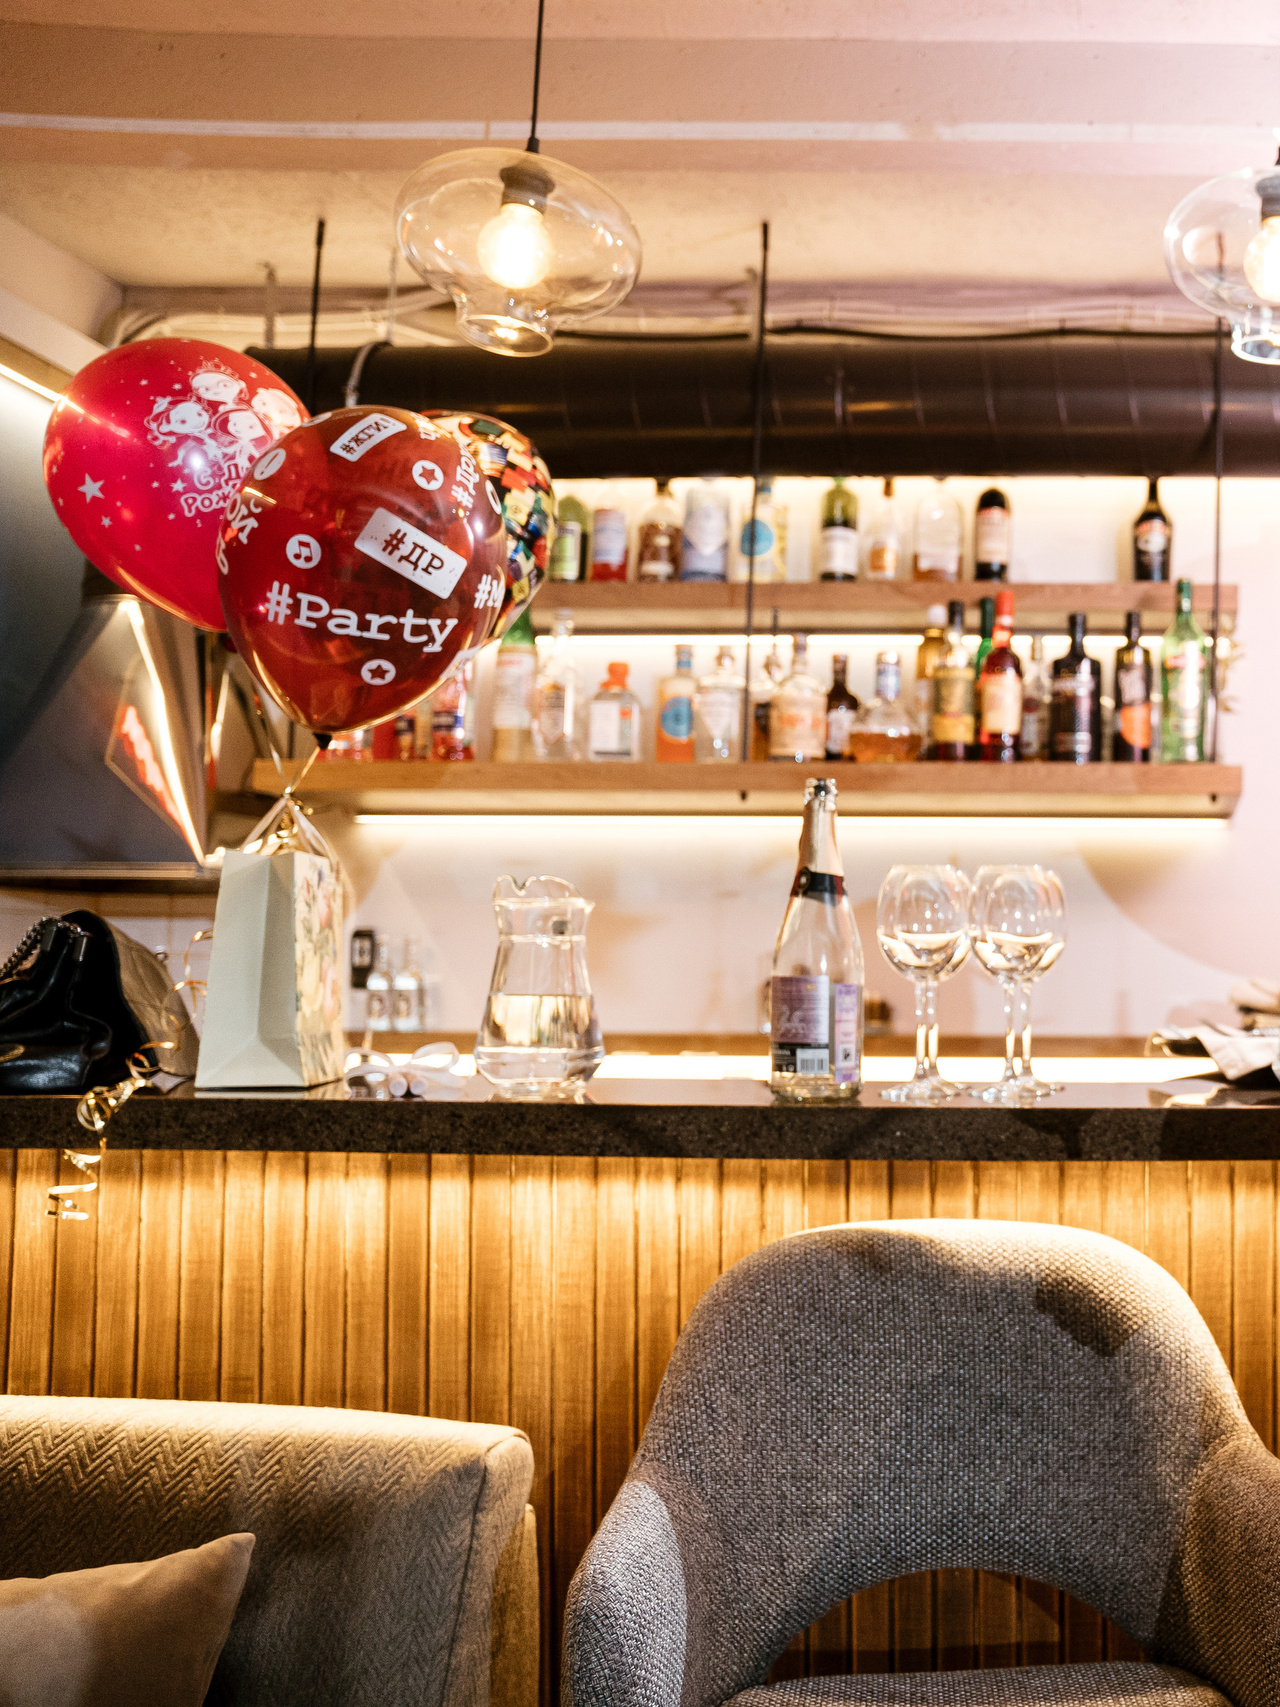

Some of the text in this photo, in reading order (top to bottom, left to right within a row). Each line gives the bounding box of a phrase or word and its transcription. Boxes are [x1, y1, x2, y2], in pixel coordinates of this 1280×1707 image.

[180, 489, 232, 517] РОЖ
[381, 528, 444, 575] #ДР
[265, 580, 459, 653] #Party
